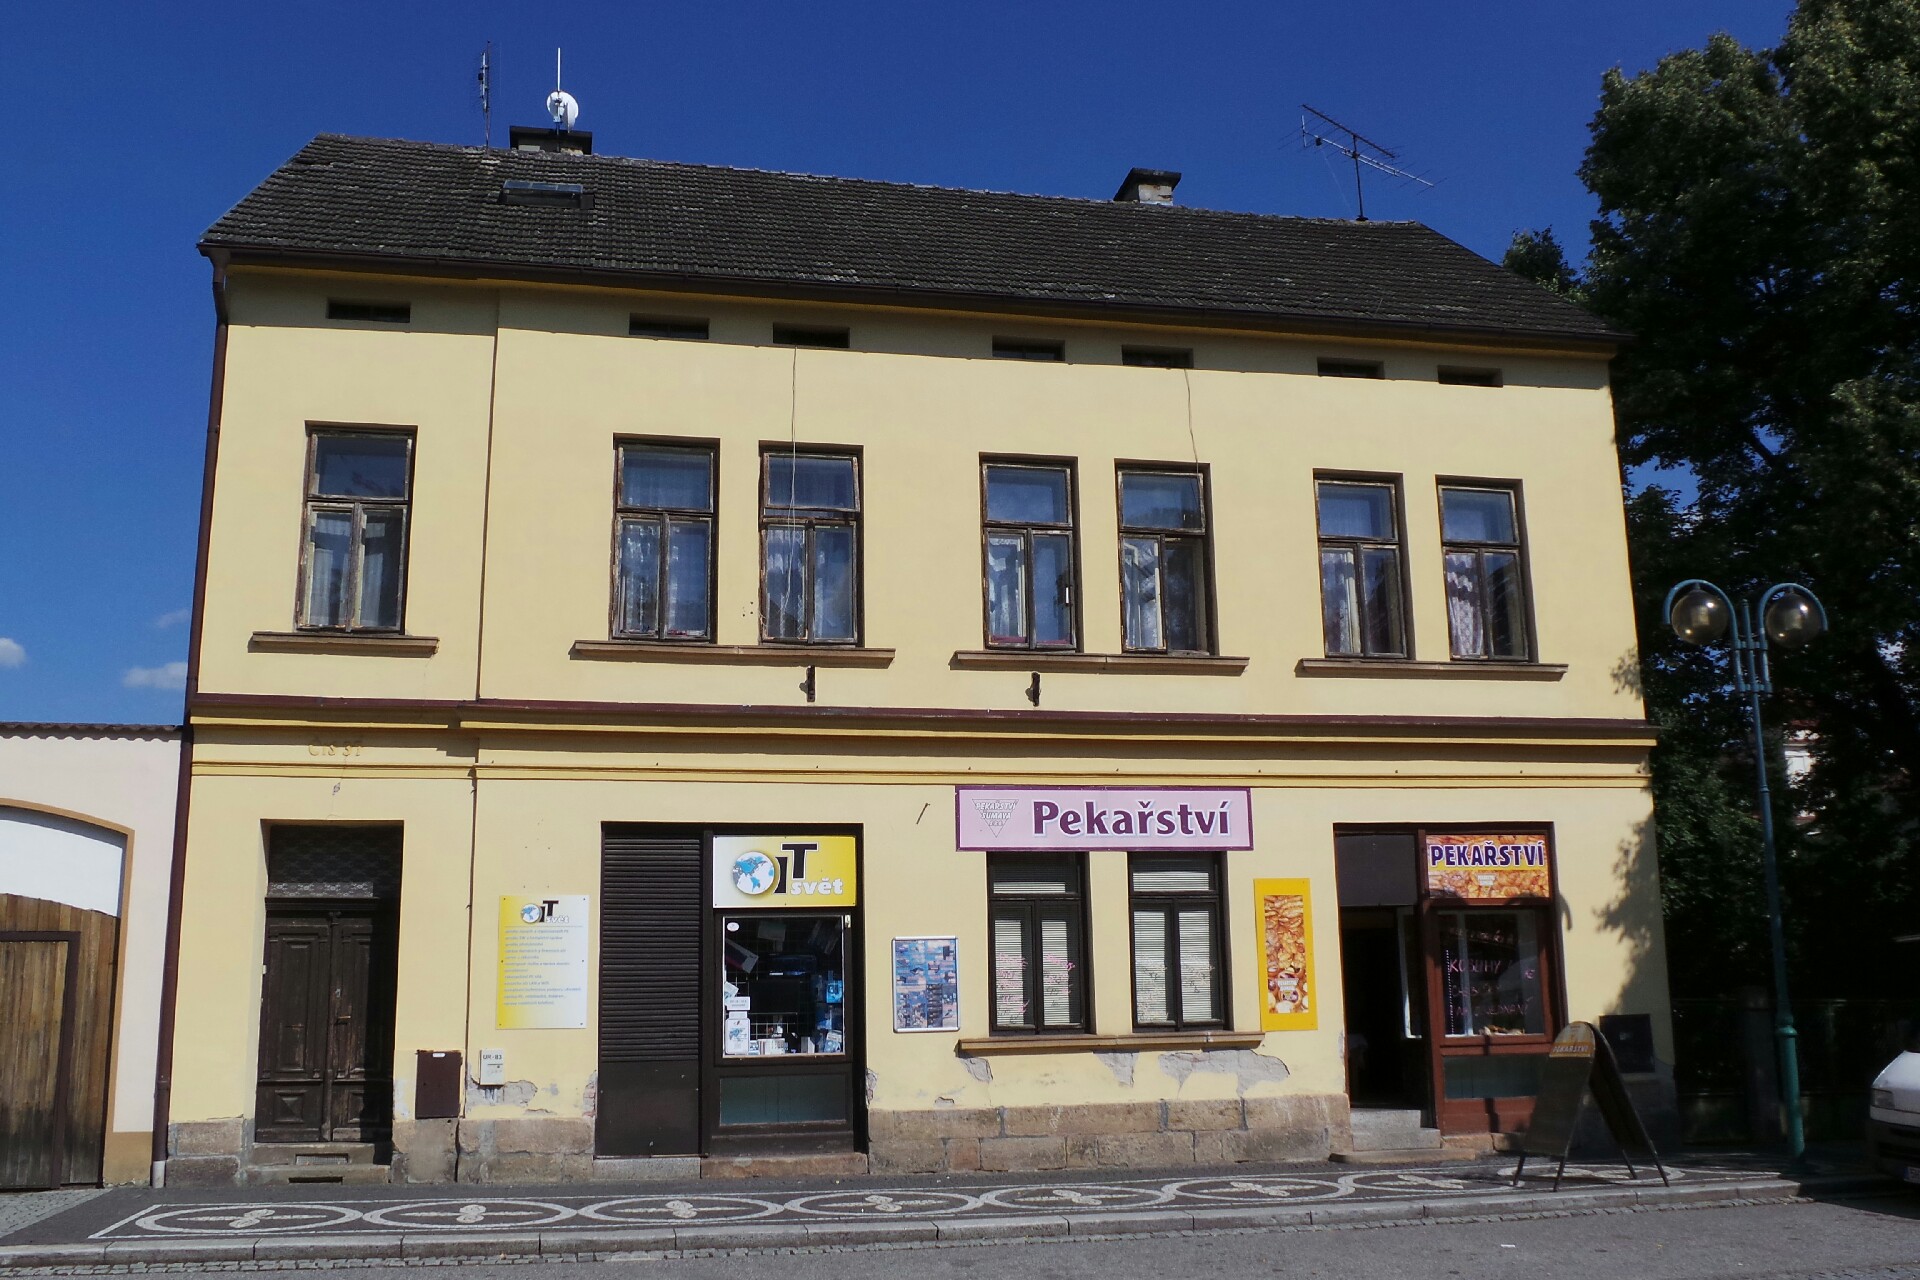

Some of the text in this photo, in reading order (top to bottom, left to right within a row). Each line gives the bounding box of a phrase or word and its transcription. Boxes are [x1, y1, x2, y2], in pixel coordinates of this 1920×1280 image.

[1033, 800, 1229, 835] Pekařství
[1430, 841, 1545, 866] PEKAŘSTVÍ
[772, 842, 818, 895] IT
[790, 878, 843, 895] svět
[538, 900, 559, 922] IT
